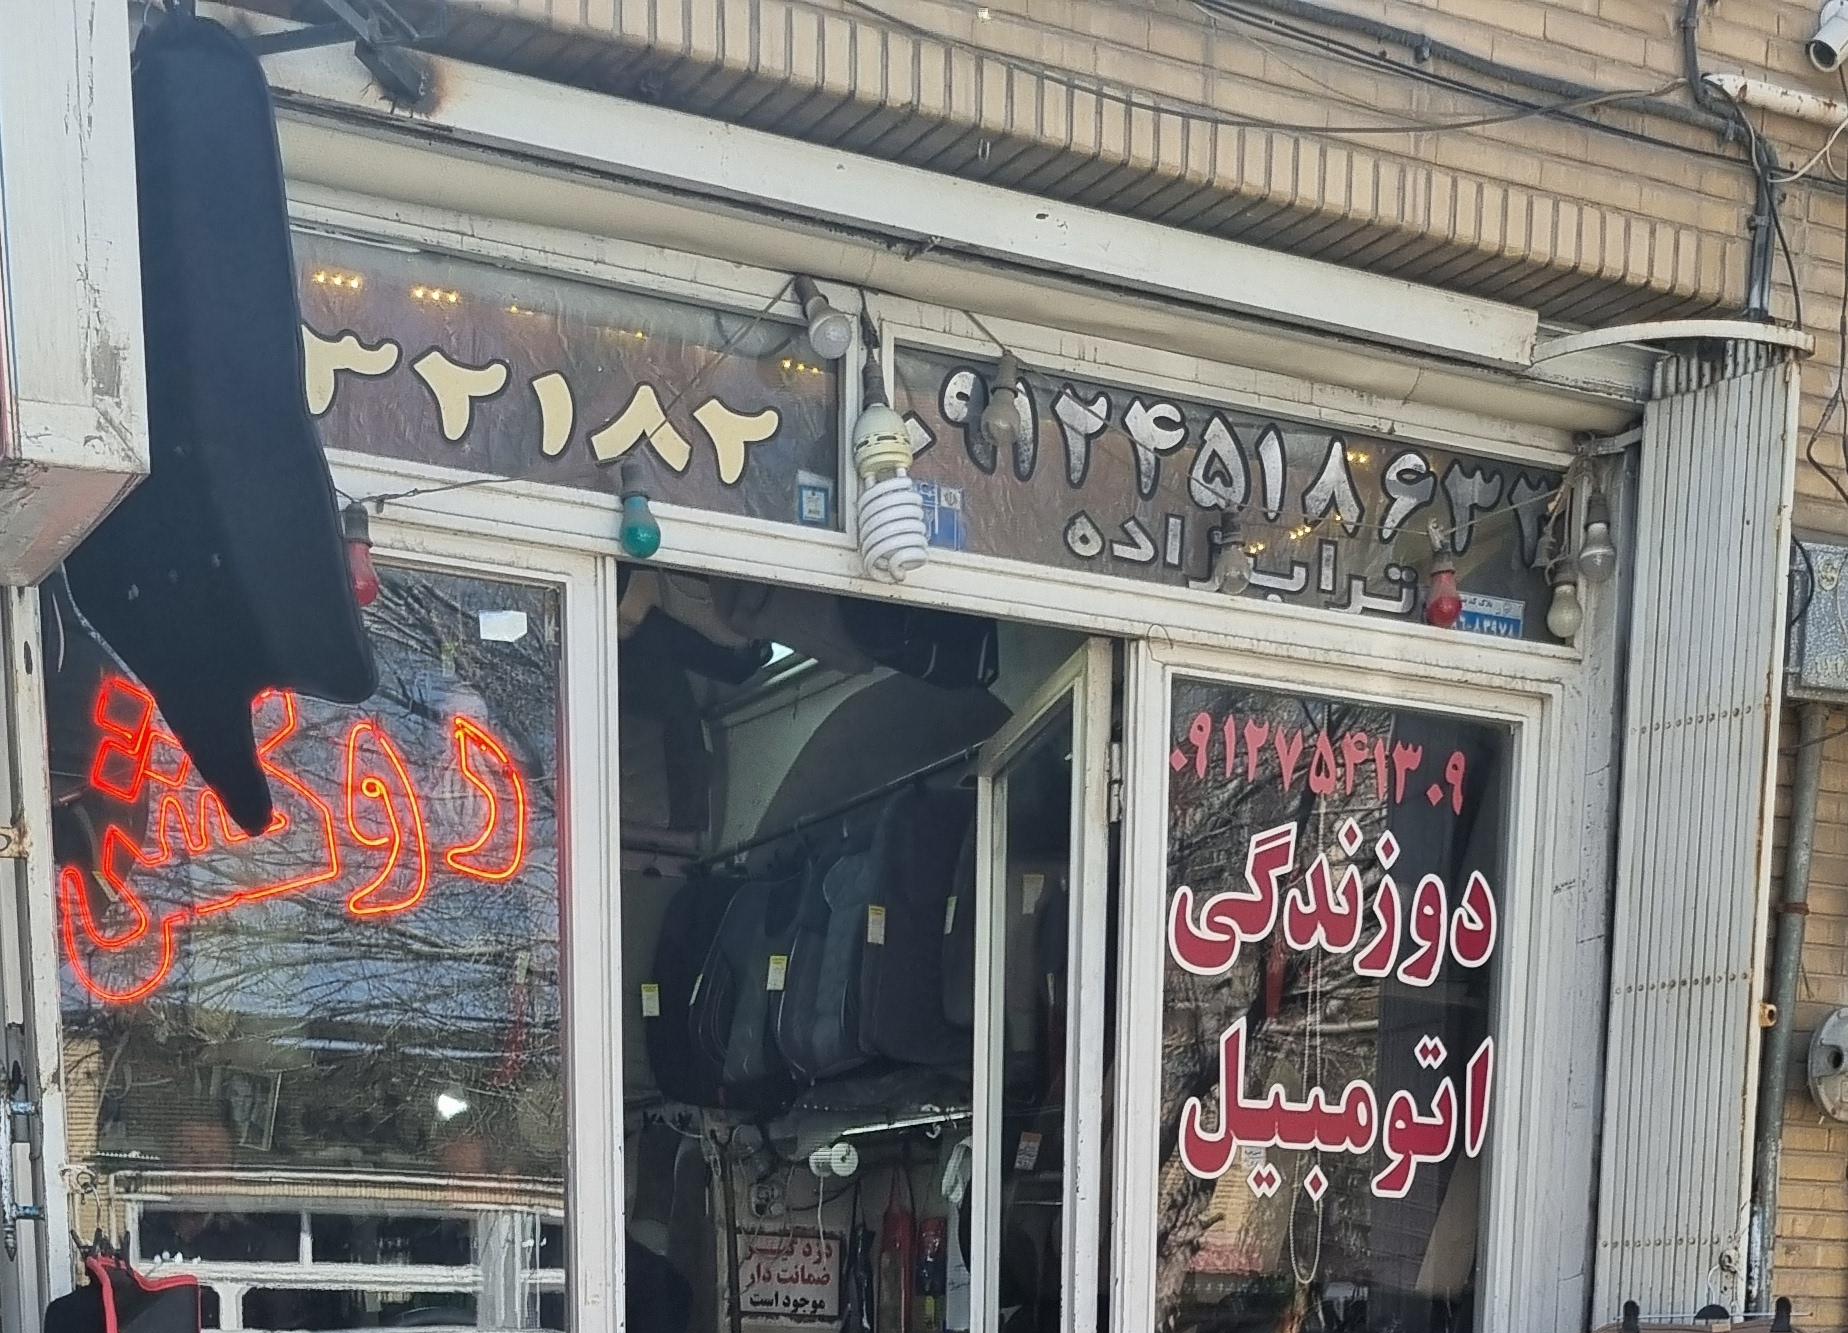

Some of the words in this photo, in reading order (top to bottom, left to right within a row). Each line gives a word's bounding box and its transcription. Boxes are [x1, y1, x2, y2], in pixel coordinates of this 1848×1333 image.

[1170, 712, 1467, 816] ۰۹۱۲۷۵۴۱۳۰۹
[61, 676, 528, 1004] روکش
[1168, 816, 1497, 987] دوزندگی
[1179, 1016, 1494, 1201] اتومبیل
[746, 1263, 772, 1287] دار
[749, 1291, 779, 1307] است
[777, 1264, 832, 1285] ضمانت
[782, 1295, 826, 1314] موجود
